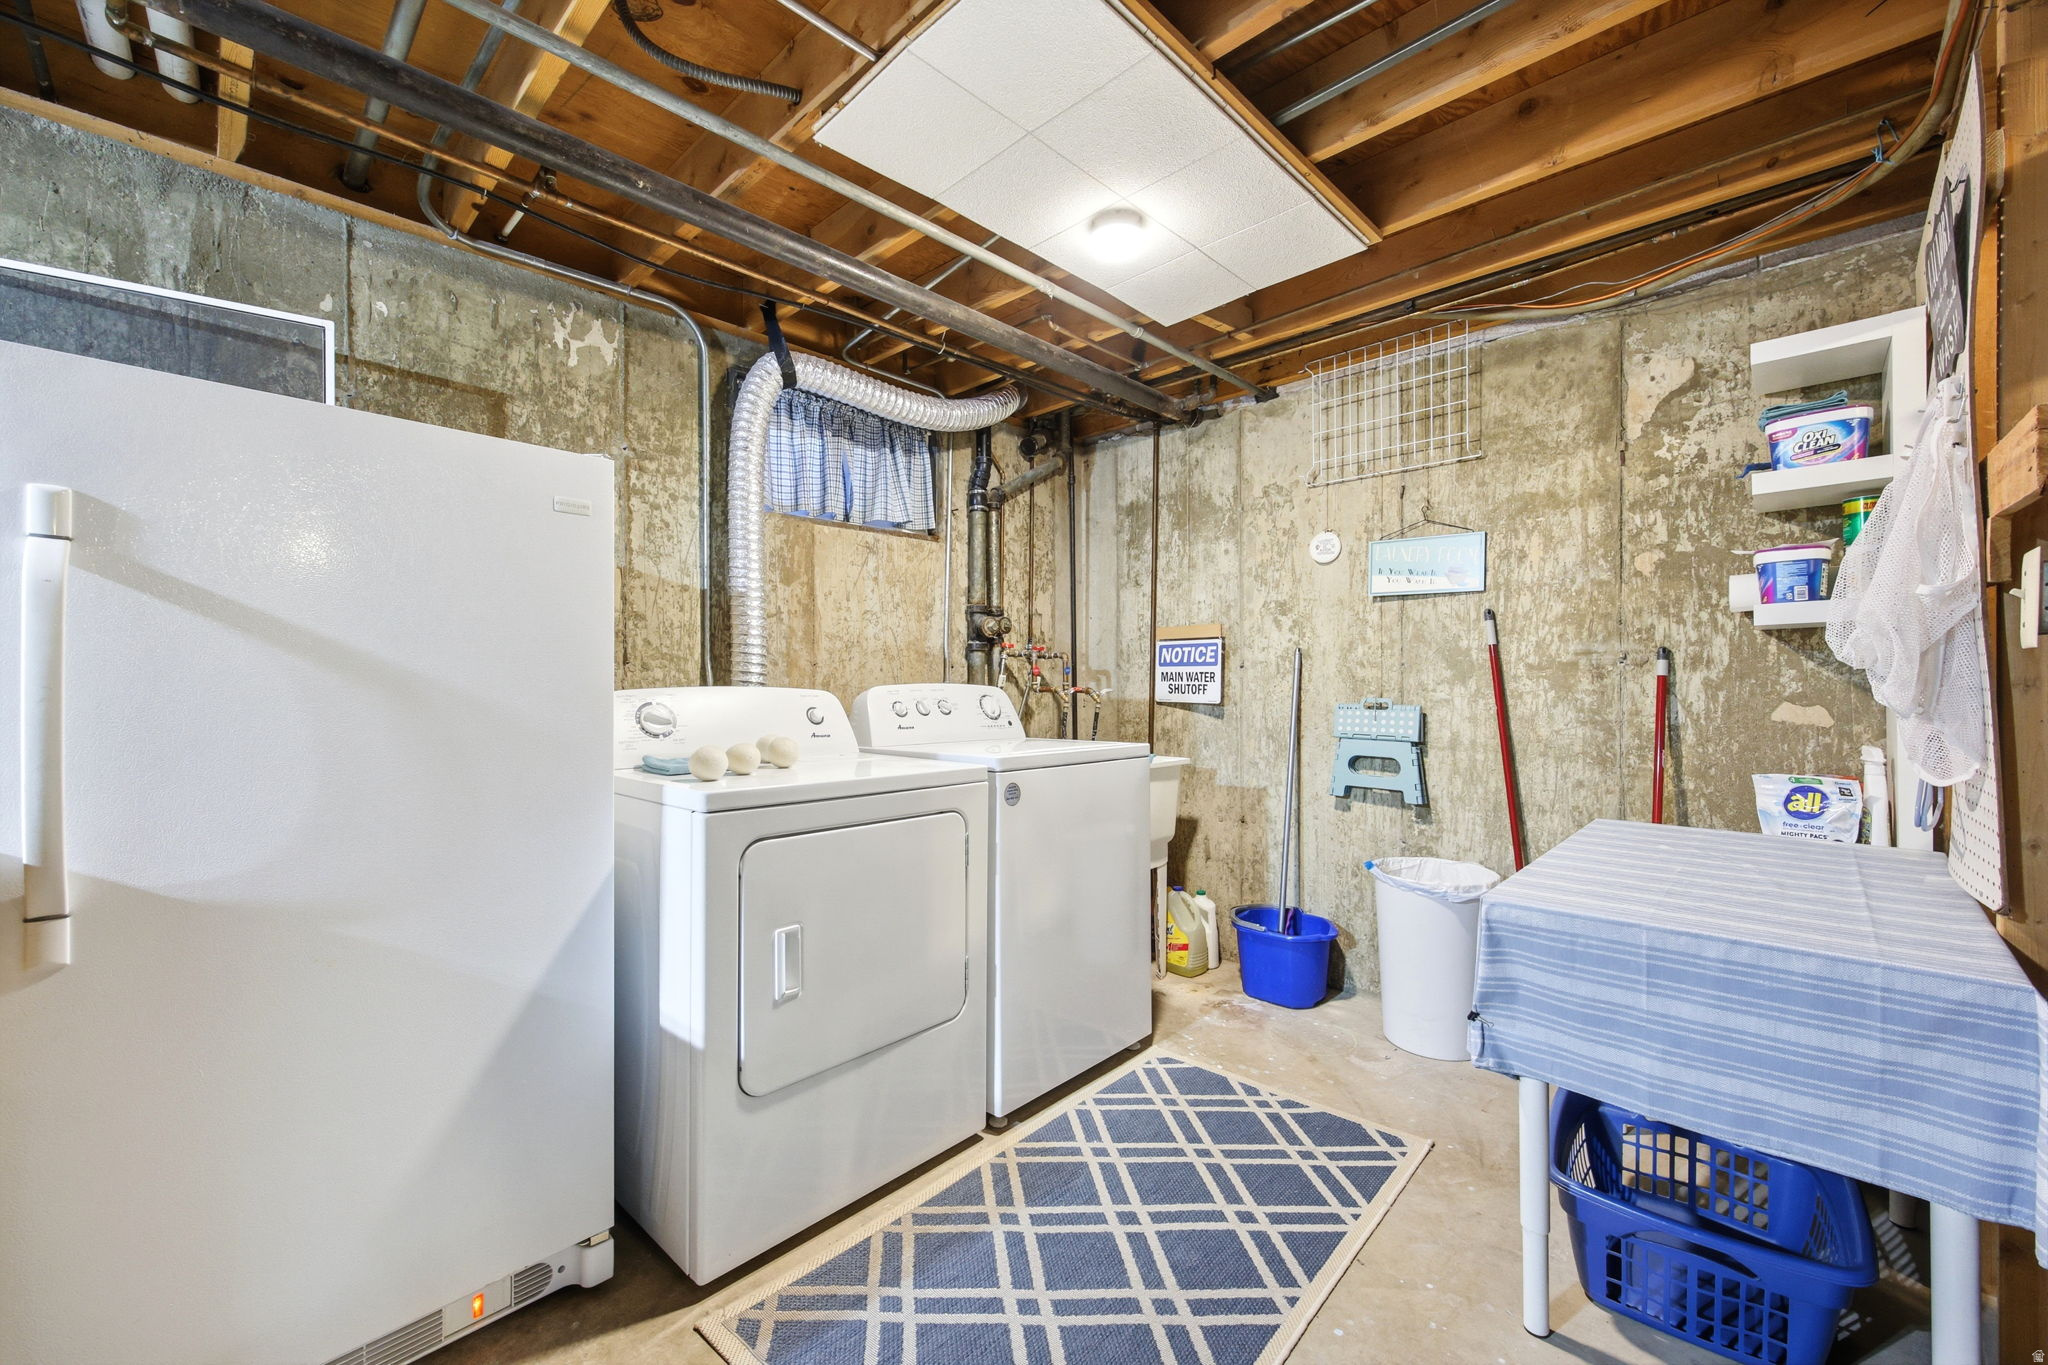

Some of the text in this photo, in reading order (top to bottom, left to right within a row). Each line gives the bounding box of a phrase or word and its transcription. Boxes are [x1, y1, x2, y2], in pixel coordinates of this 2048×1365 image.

[1803, 429, 1828, 443] OXI
[1793, 434, 1836, 453] CLEAN
[1160, 646, 1217, 664] NOTICE
[1161, 672, 1216, 683] MAIN WATER
[1168, 683, 1208, 695] SHUTOFF
[1787, 792, 1822, 813] all
[1782, 821, 1825, 831] free clear
[1780, 831, 1808, 839] MIGHTY
